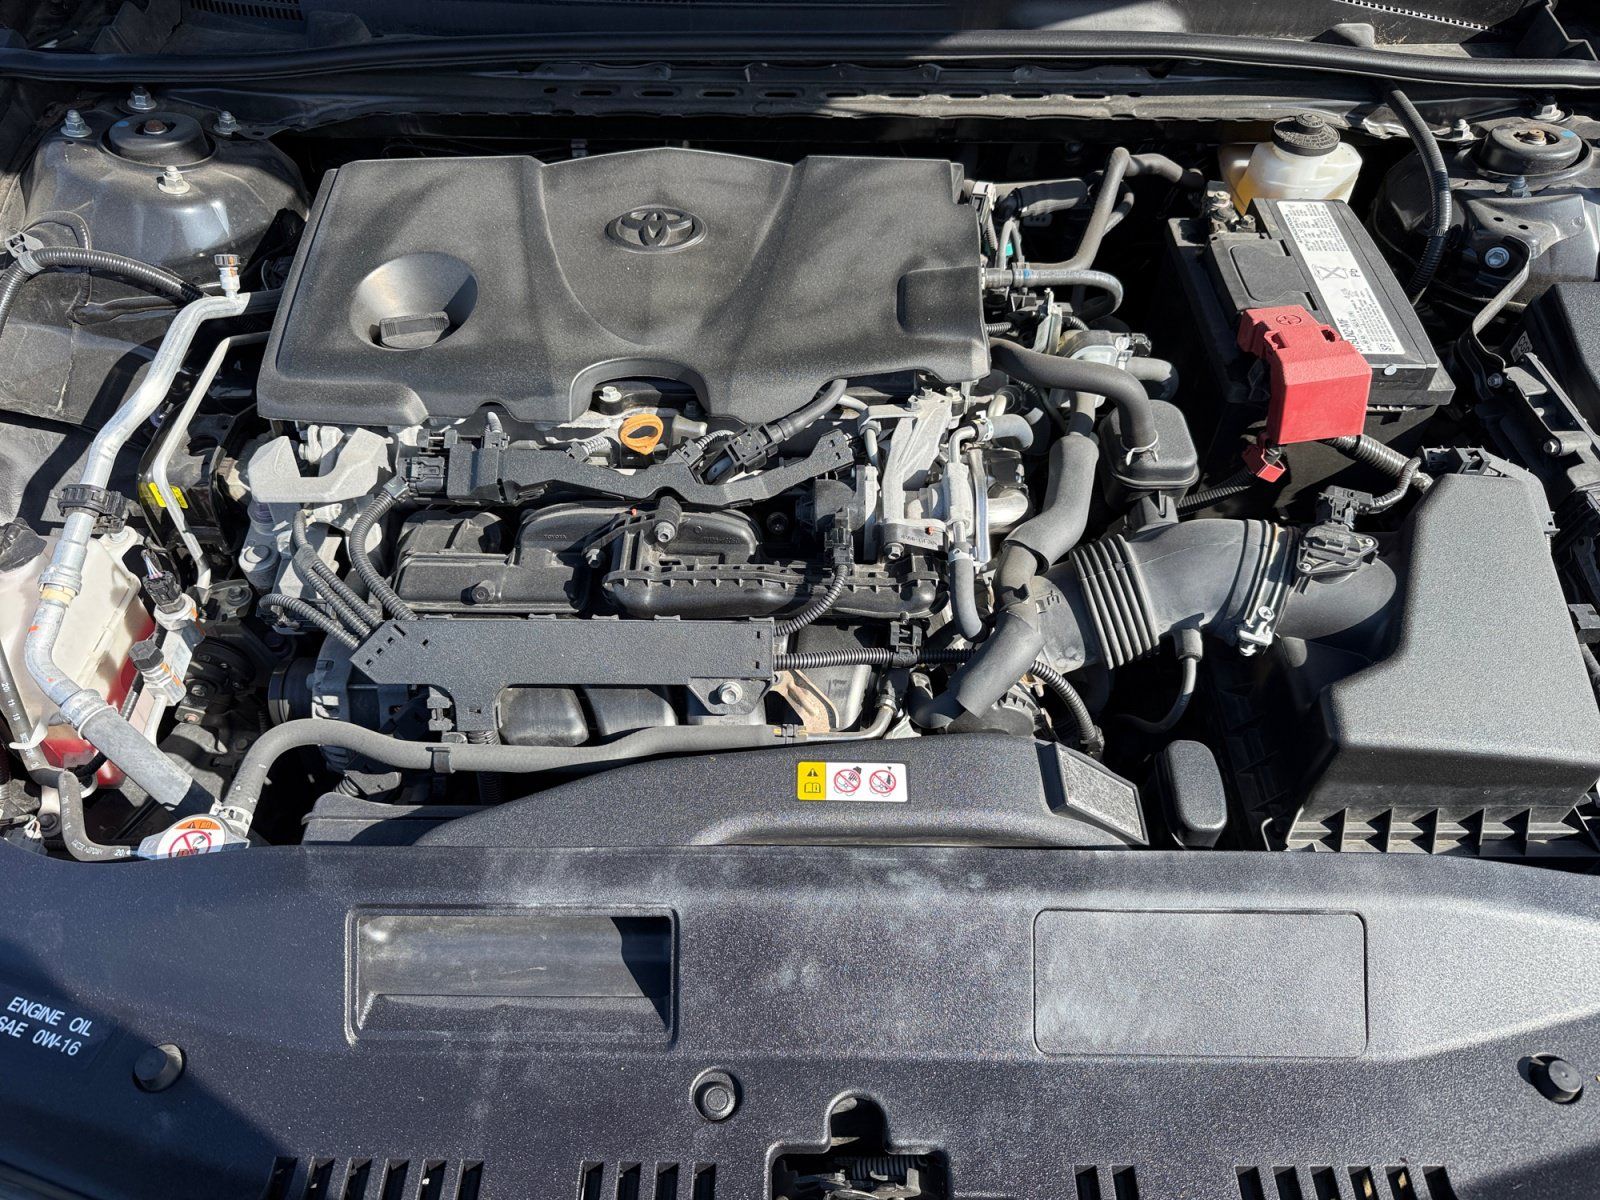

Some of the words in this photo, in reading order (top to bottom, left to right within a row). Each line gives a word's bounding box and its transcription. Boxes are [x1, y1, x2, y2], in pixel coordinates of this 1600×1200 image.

[0, 1016, 29, 1038] SAE
[32, 1029, 82, 1056] 0W-16
[7, 996, 65, 1026] ENGINE
[69, 1017, 92, 1037] OIL
